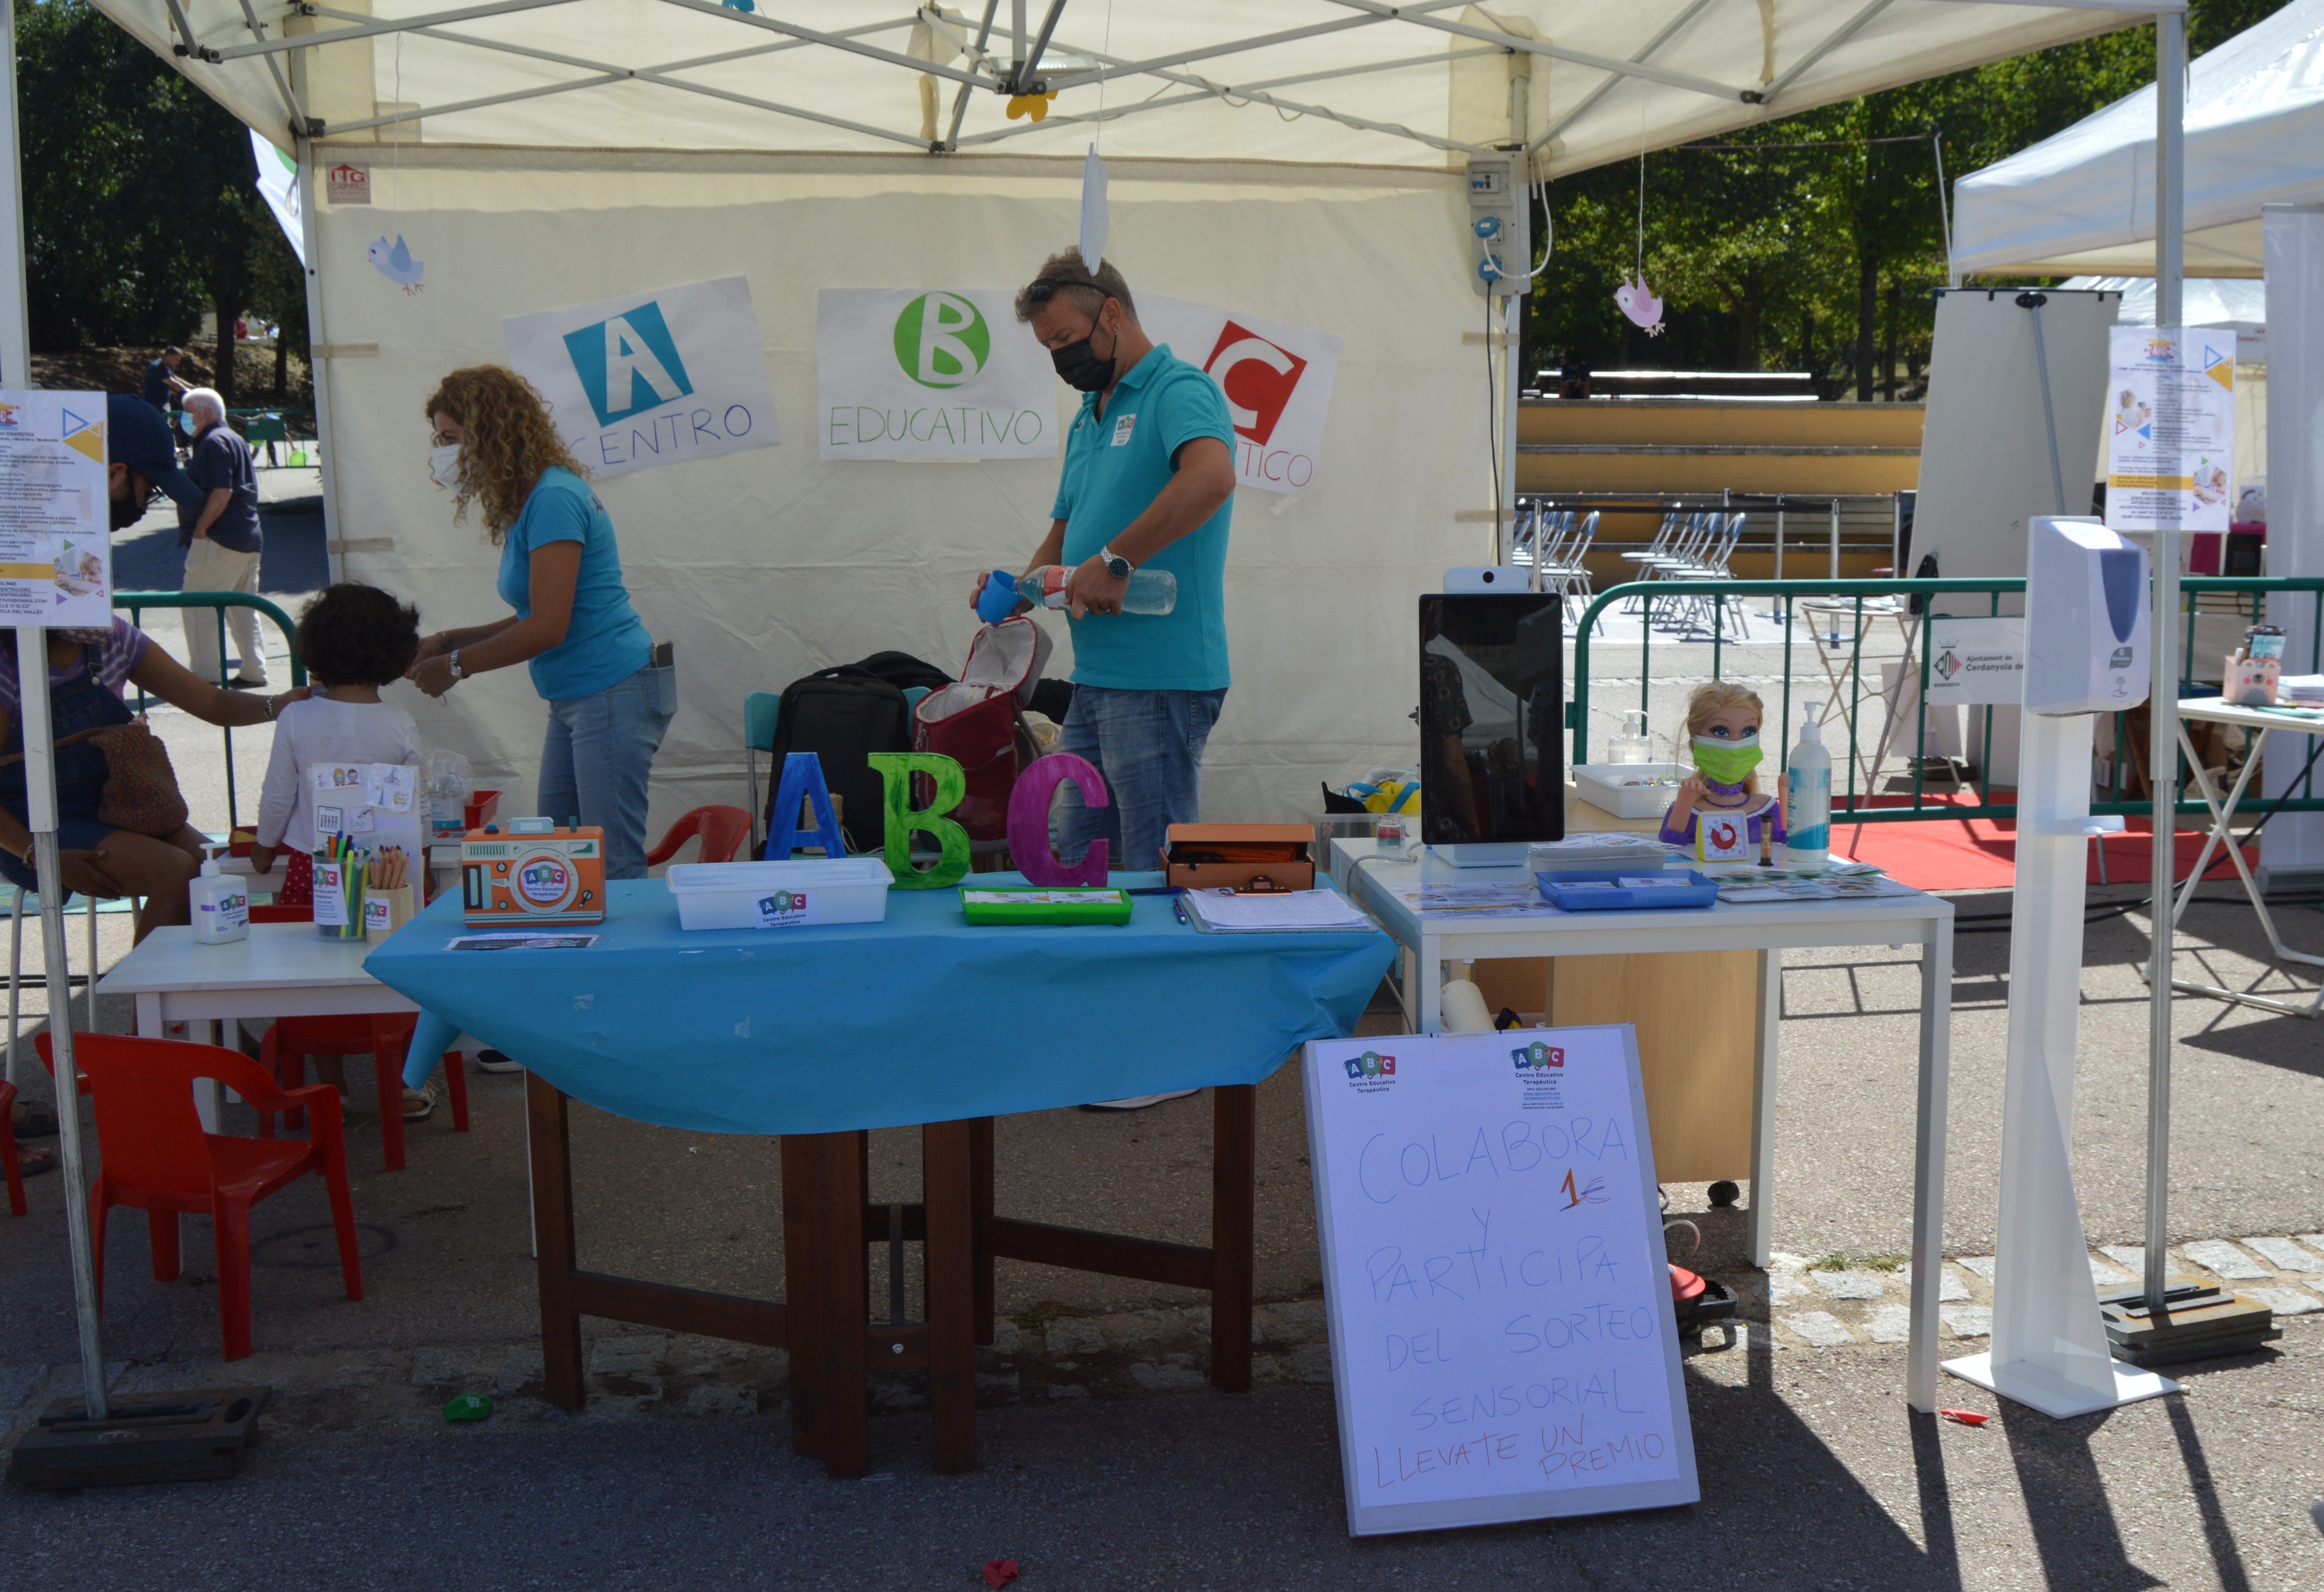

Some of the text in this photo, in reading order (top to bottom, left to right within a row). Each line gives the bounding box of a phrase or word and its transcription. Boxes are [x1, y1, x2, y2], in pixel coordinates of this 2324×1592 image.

[918, 292, 978, 385] B
[605, 317, 685, 414] A
[831, 406, 1042, 445] EDUCATIVO
[1966, 663, 2012, 672] Cerdanyola
[1967, 655, 2003, 663] Ajuntament
[529, 870, 562, 881] ABC
[765, 896, 802, 911] ABC
[1351, 1057, 1391, 1075] ABC
[1518, 1048, 1560, 1065] ABC
[1359, 1116, 1627, 1204] COLABORA
[1386, 1301, 1653, 1371] DEL SORTEO
[1410, 1369, 1644, 1430] SENSORIAL
[1375, 1413, 1584, 1488] LLEVATE UN
[1539, 1431, 1665, 1482] PREMIO
